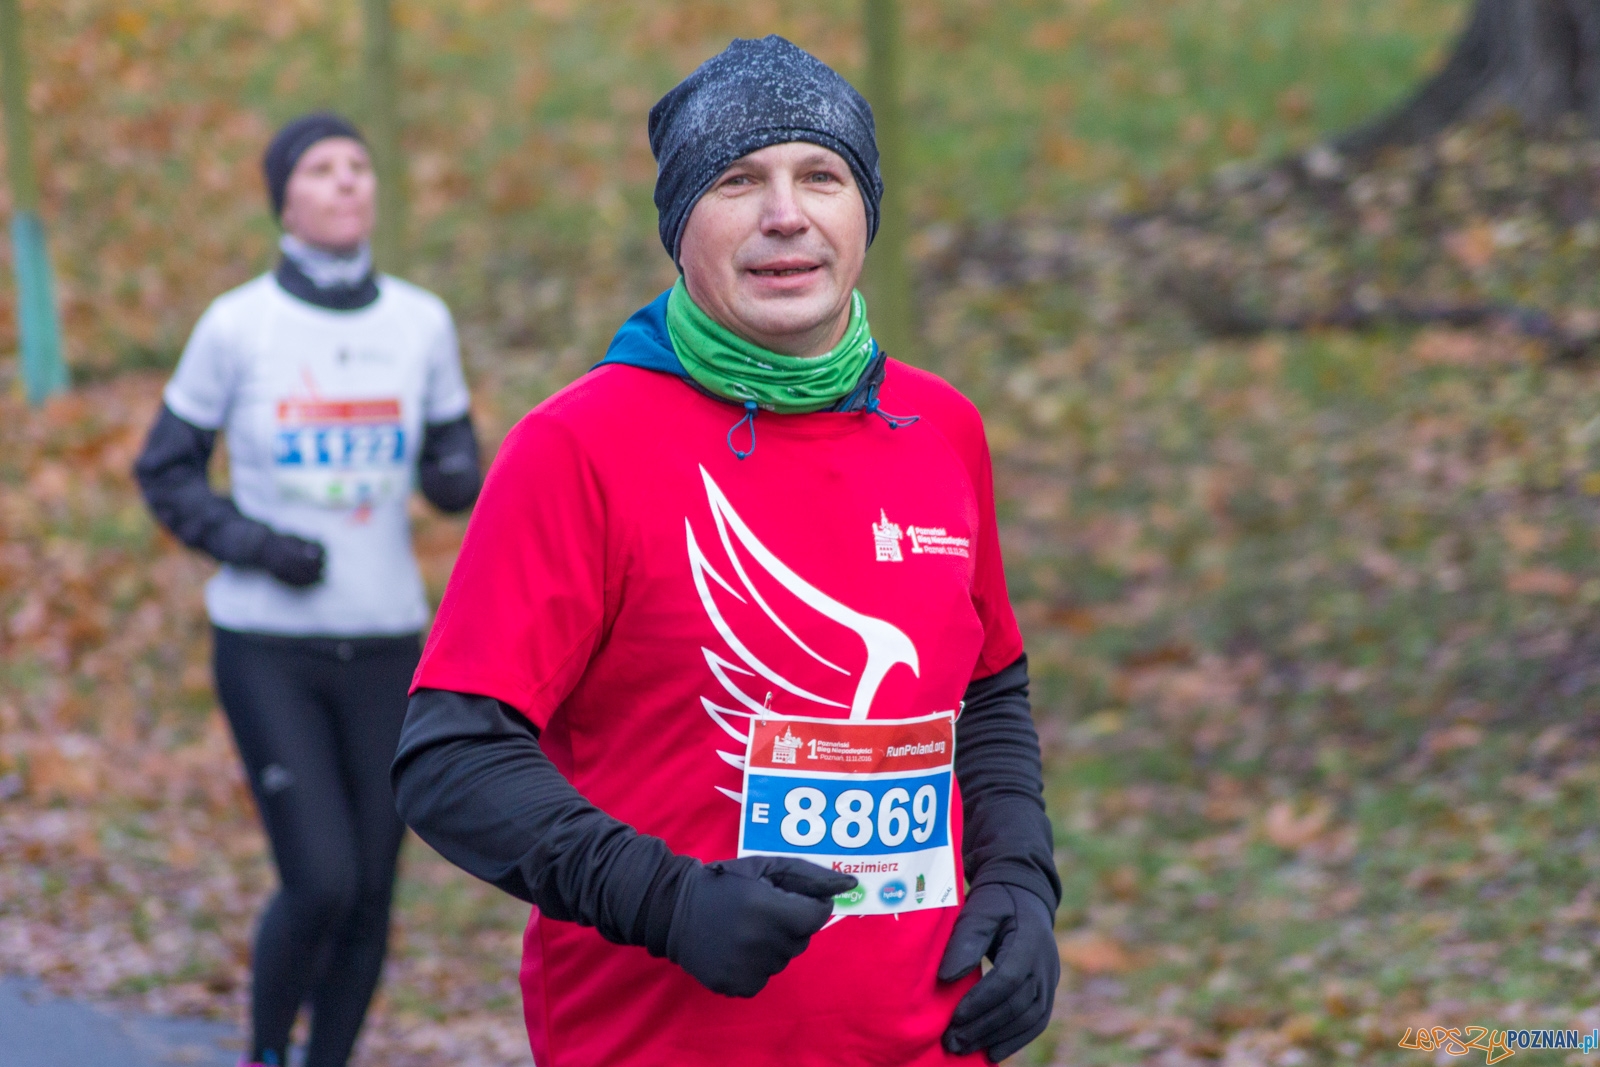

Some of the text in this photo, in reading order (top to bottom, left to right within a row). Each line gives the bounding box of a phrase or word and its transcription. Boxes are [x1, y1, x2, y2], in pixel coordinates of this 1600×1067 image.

[906, 525, 923, 553] 1
[807, 739, 818, 759] 1
[817, 740, 849, 748] Poznański
[886, 741, 945, 757] RunPoland.org
[752, 784, 937, 849] E 8869
[832, 861, 899, 875] Kazimierz
